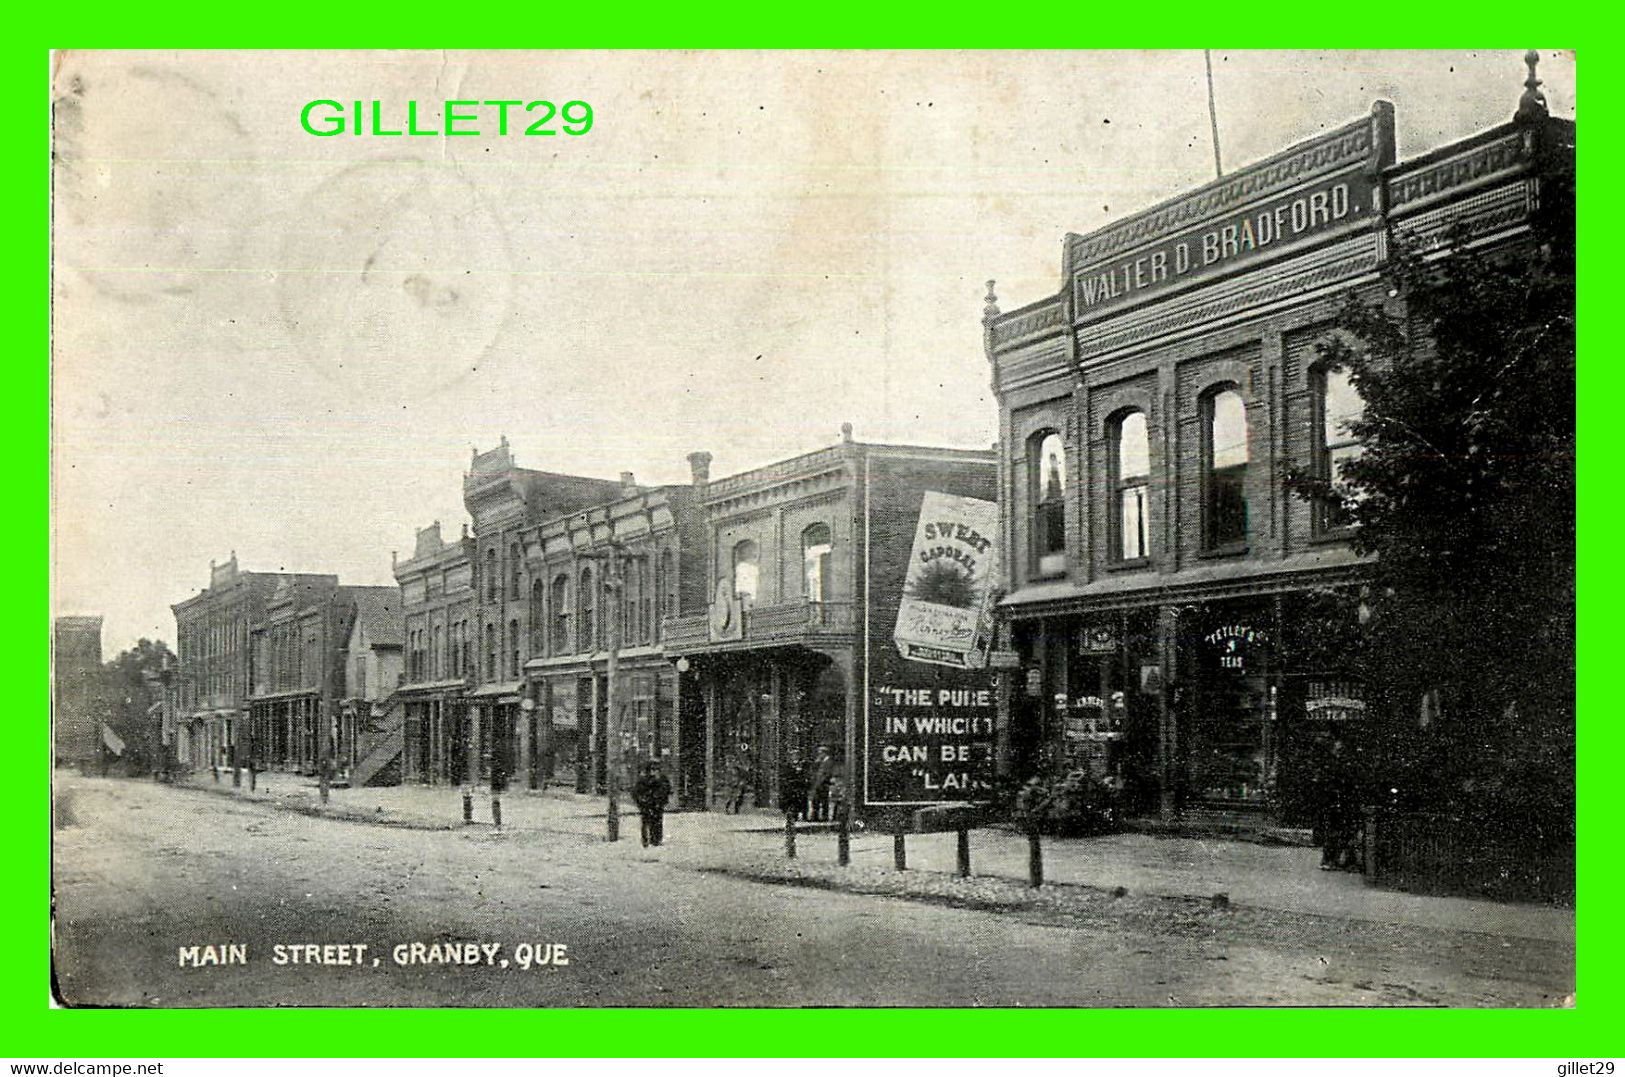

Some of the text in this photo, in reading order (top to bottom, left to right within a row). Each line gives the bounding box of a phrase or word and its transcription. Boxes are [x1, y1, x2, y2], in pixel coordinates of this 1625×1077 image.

[1079, 182, 1361, 306] WALTER D. BRADFORD.
[925, 521, 992, 554] SWEET
[886, 717, 907, 734] IN
[883, 745, 928, 762] CAN
[941, 745, 969, 762] BE
